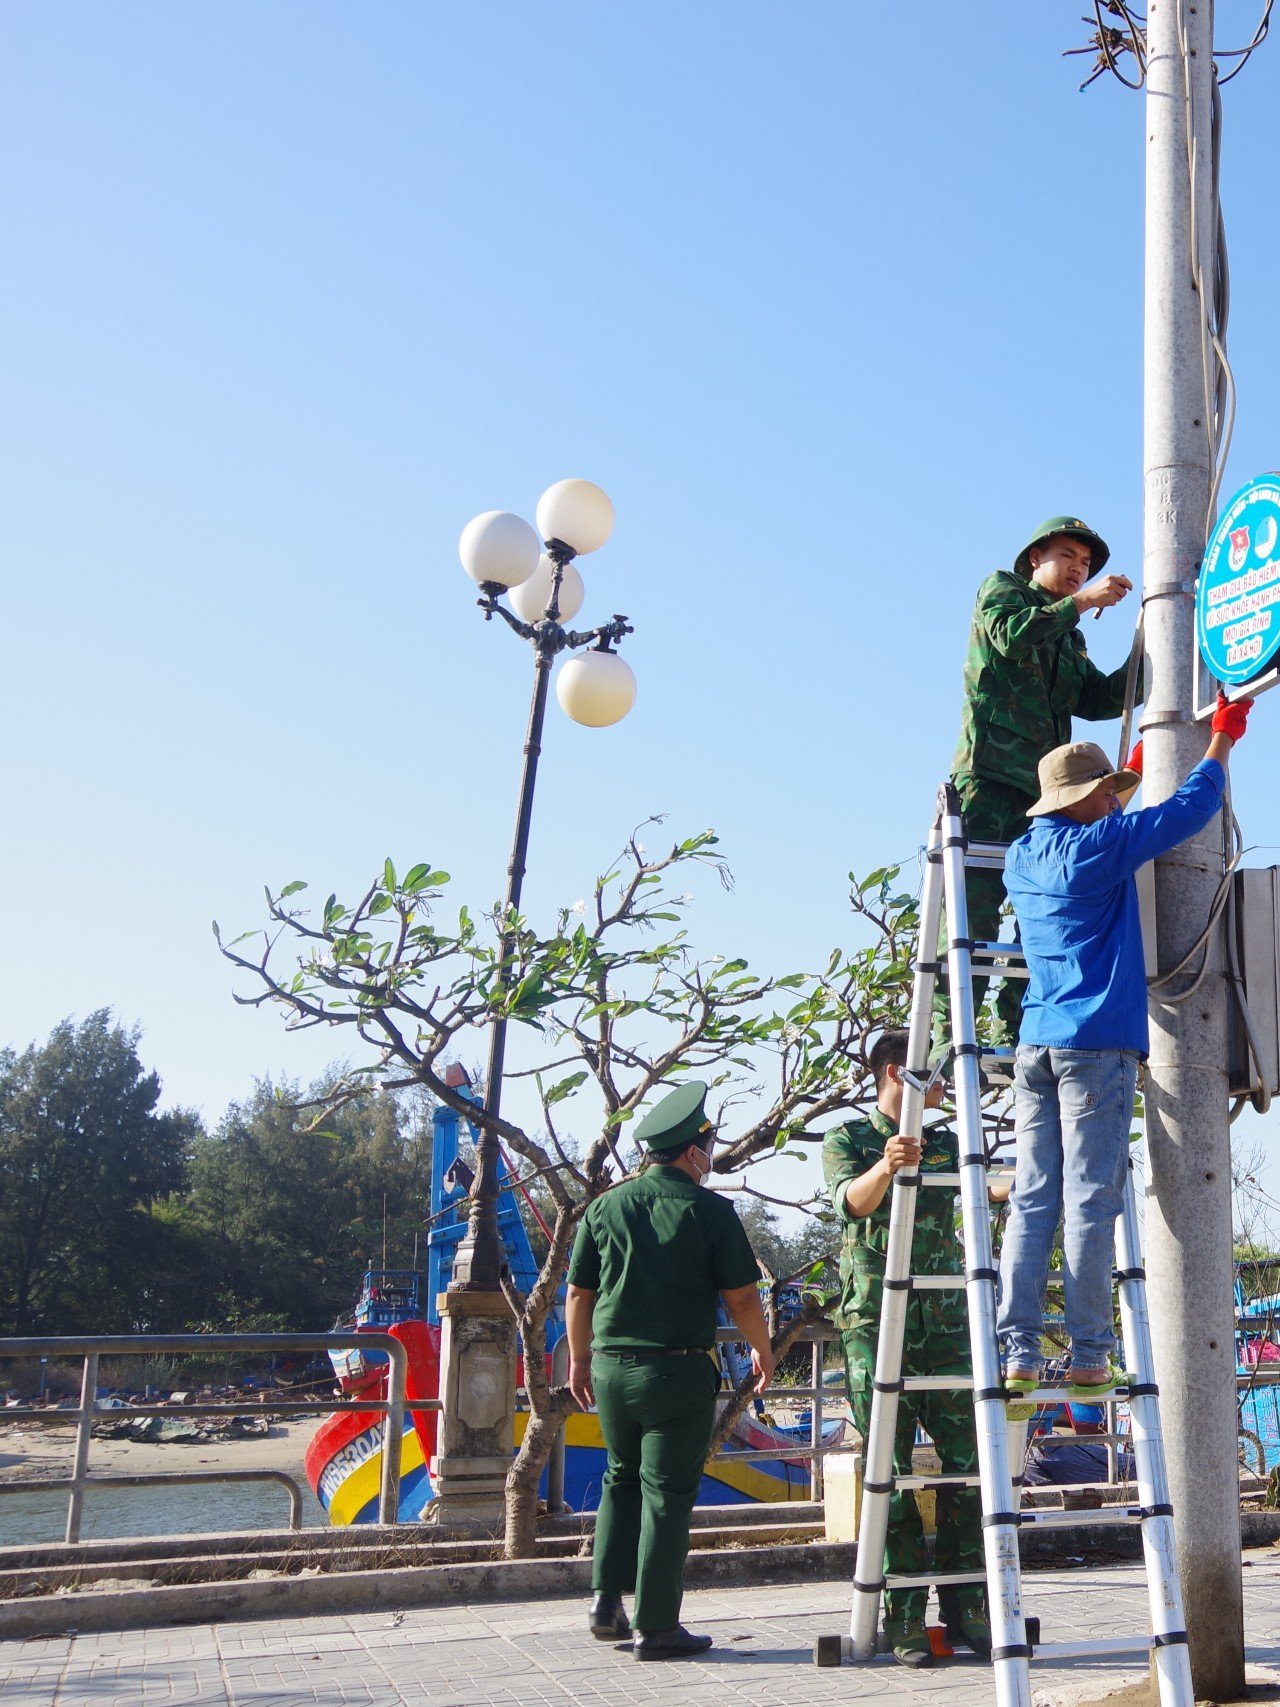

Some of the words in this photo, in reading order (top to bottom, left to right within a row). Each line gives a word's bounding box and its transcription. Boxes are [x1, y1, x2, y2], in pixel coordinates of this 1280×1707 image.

[1209, 583, 1228, 604] THAM
[1229, 578, 1241, 597] GIA
[1239, 619, 1250, 638] GIA
